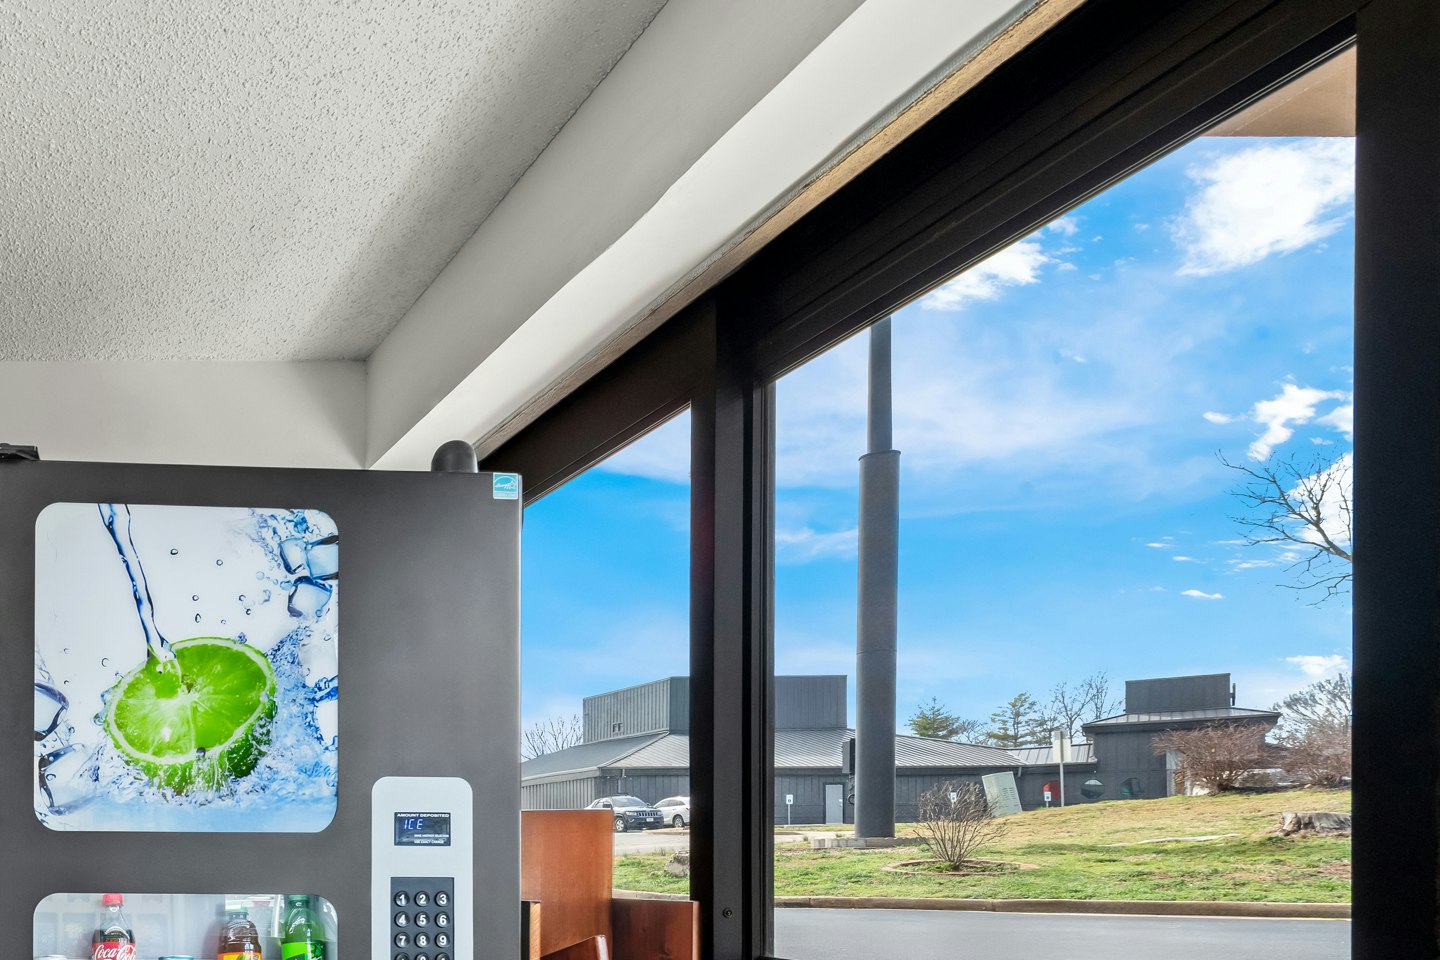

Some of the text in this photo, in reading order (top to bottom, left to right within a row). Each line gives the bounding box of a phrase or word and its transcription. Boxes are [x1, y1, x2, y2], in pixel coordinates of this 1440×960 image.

[404, 818, 423, 829] ICE
[399, 894, 406, 905] 1
[419, 894, 426, 905] 2
[439, 894, 447, 905] 3
[399, 914, 406, 925] 4
[419, 914, 426, 925] 5
[439, 914, 447, 925] 6
[399, 935, 406, 946] 7
[419, 935, 426, 946] 8
[439, 935, 447, 946] 9
